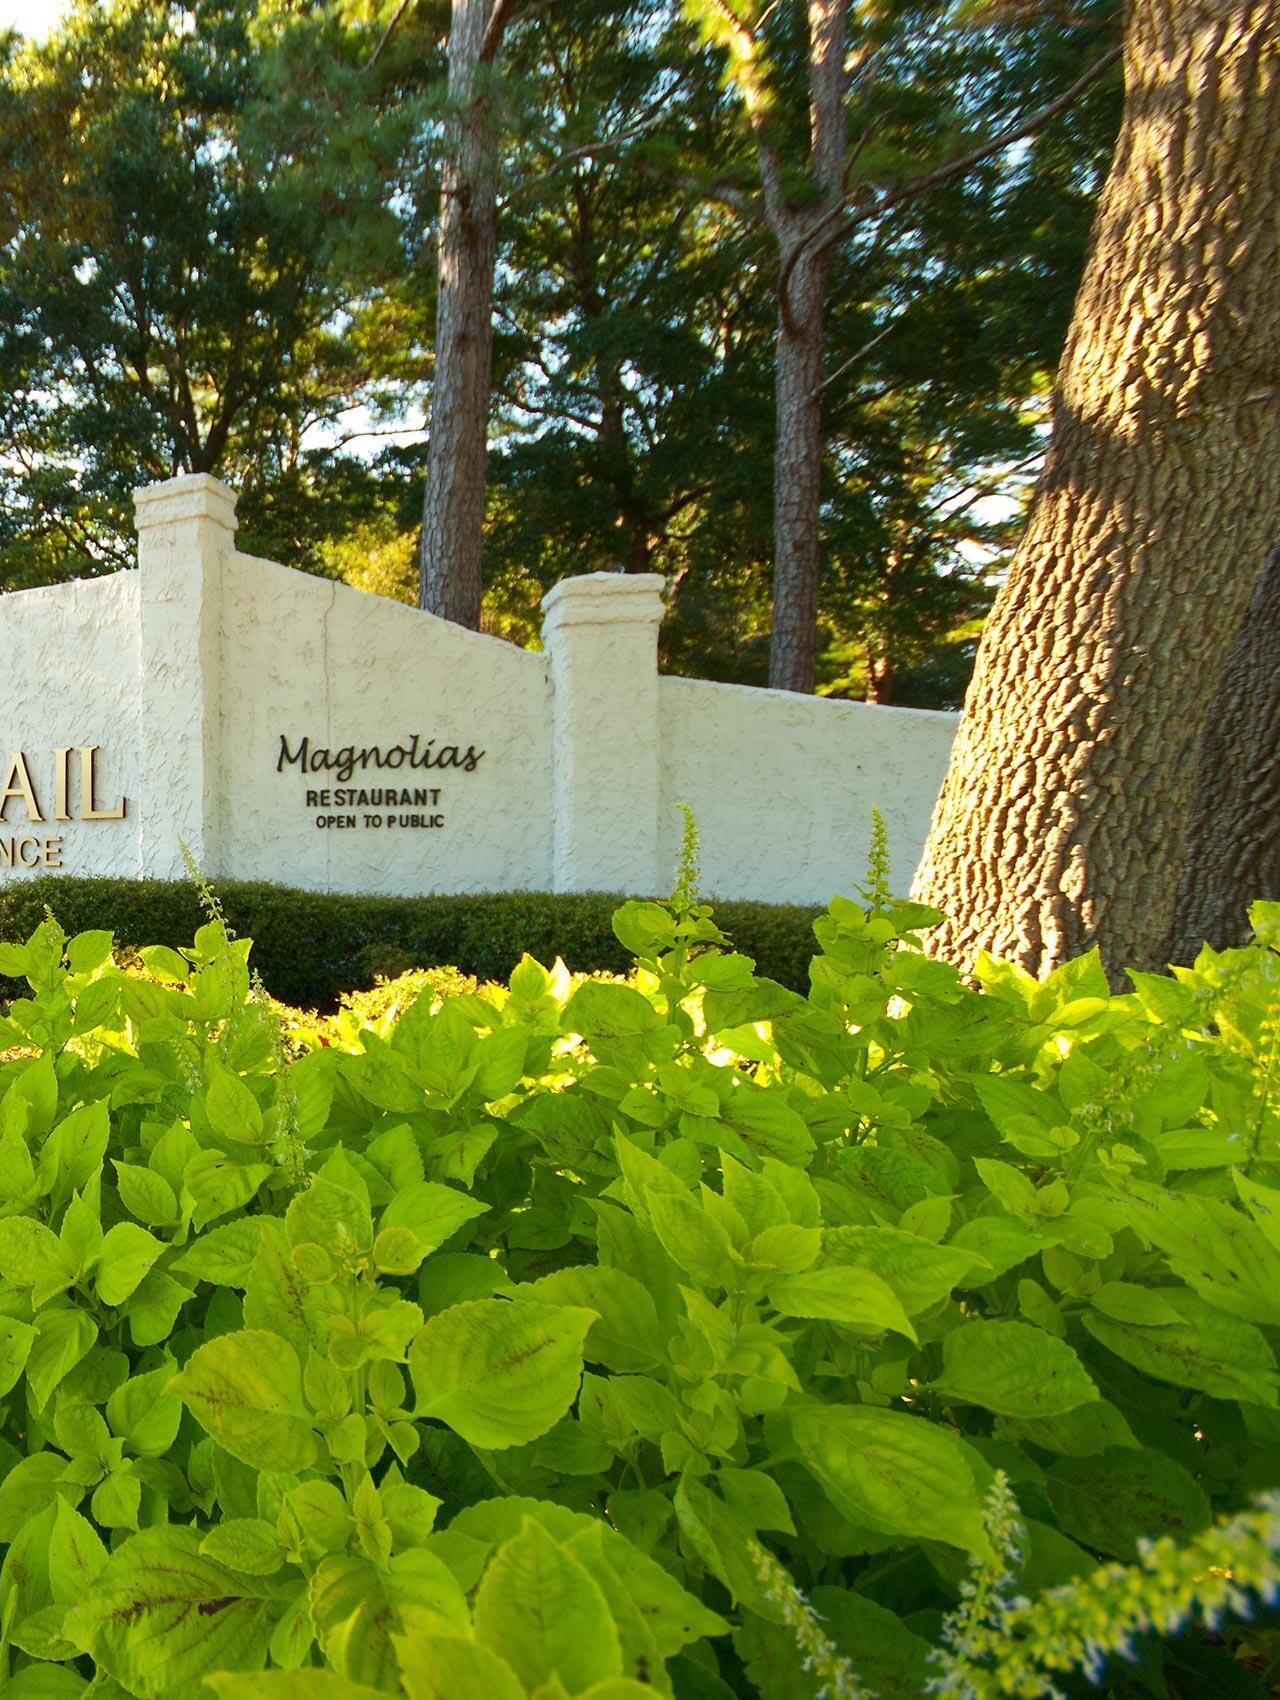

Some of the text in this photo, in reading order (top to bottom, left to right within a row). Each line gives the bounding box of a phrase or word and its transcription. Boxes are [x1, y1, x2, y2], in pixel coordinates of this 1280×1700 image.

[276, 734, 486, 782] Magnolias
[306, 788, 442, 807] RESTAURANT
[316, 814, 444, 828] OPEN TO PUBLIC
